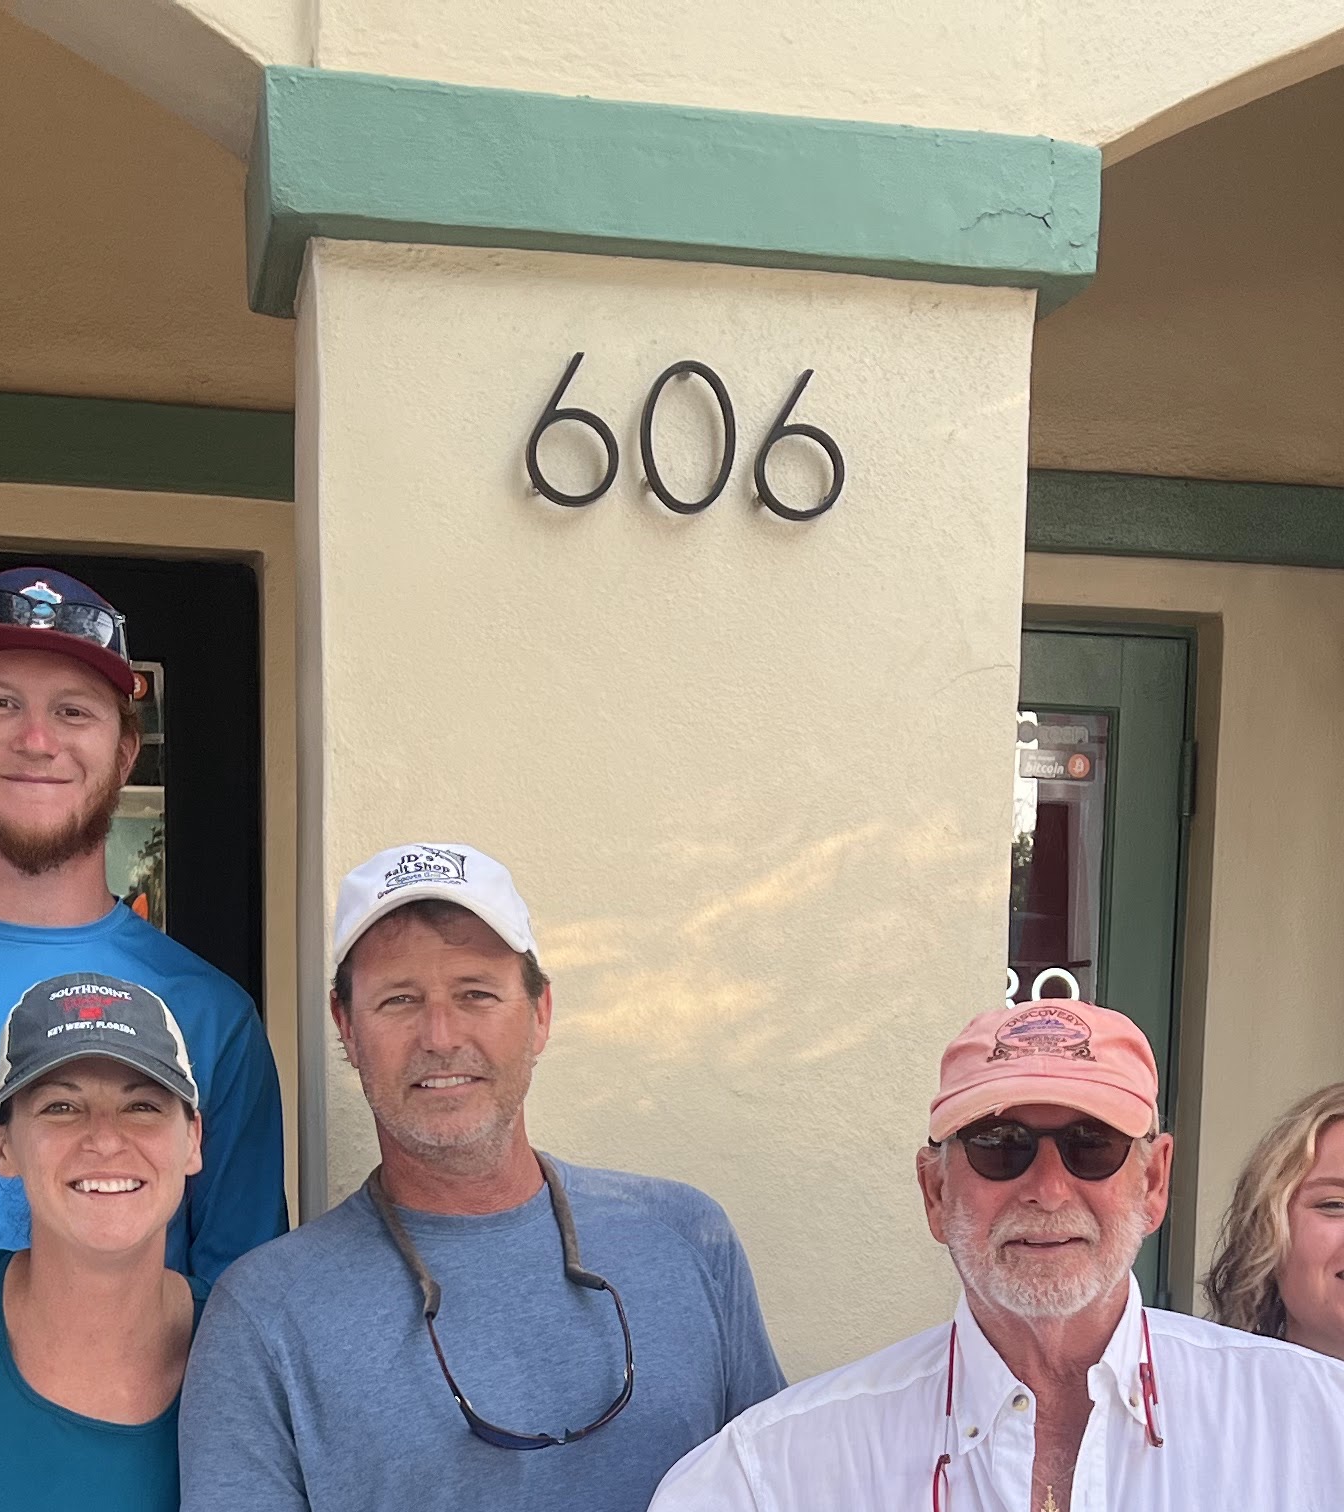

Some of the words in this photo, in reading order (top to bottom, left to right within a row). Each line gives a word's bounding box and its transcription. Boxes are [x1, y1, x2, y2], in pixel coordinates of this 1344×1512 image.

[526, 352, 845, 522] 606
[1025, 761, 1065, 775] bitcoin
[413, 861, 451, 874] Shop
[48, 984, 133, 1001] SOUTHPOINT
[1005, 1009, 1084, 1028] DISCOVERY
[96, 1020, 137, 1036] FLORIDA
